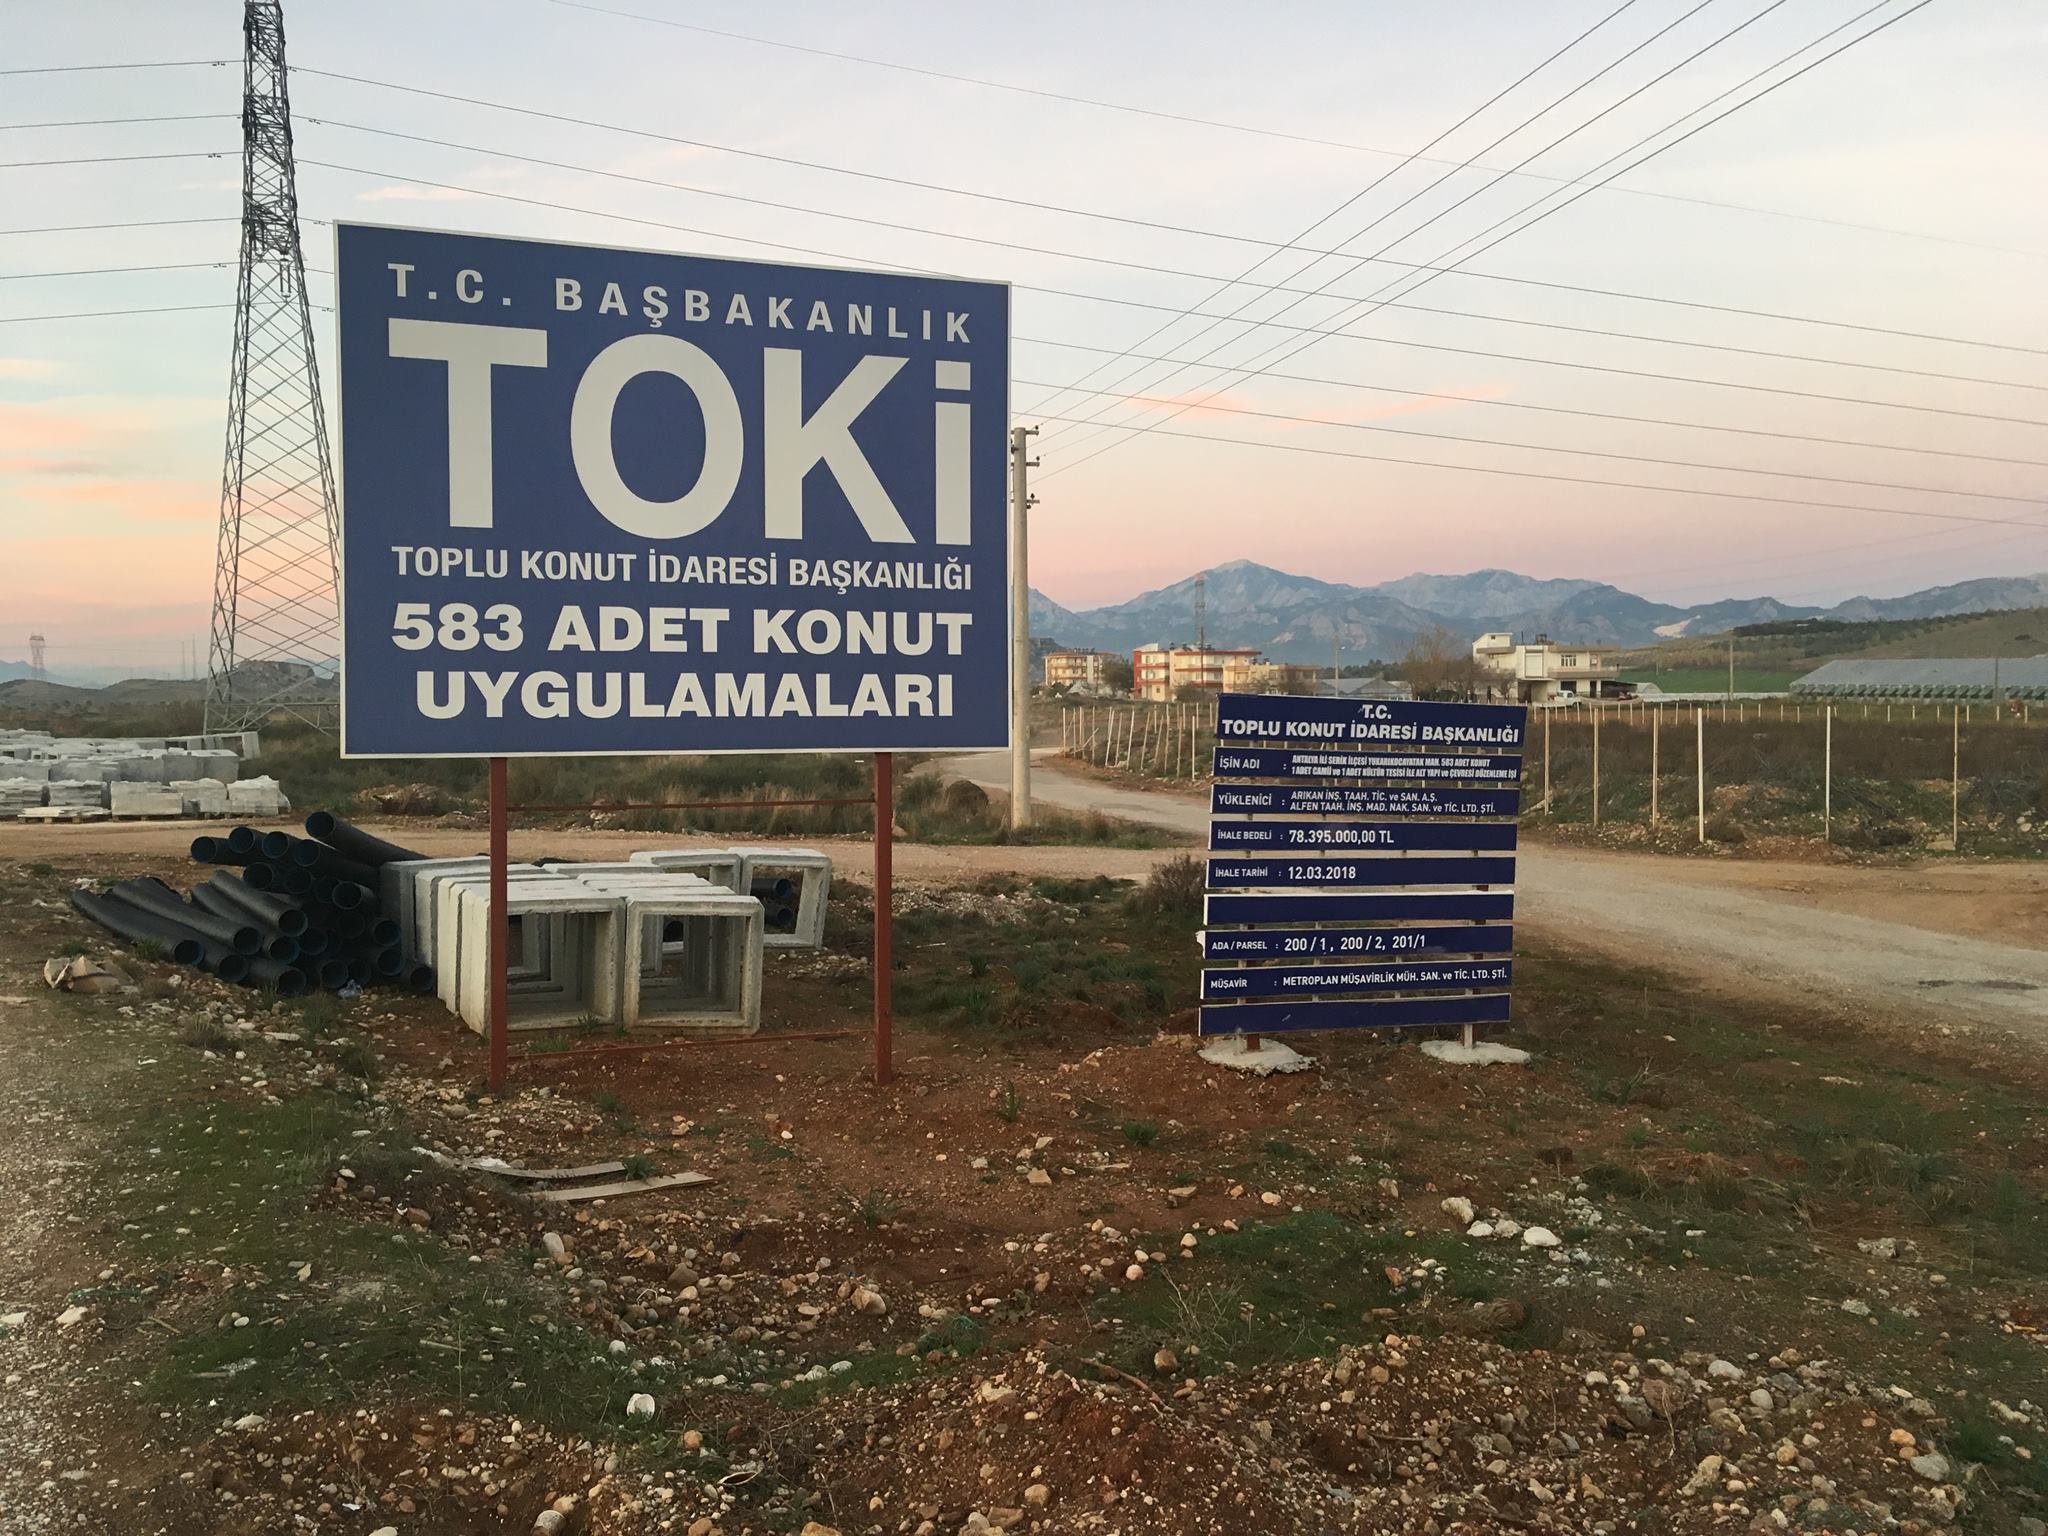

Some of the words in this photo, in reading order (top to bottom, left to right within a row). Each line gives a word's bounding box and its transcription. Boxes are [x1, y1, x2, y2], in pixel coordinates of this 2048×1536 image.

[387, 263, 513, 307] T.C.
[555, 277, 971, 345] BAŞBAKANLIK
[391, 546, 508, 578] TOPLU
[521, 551, 637, 583] KONUT
[648, 548, 777, 586] İDARESİ
[789, 556, 971, 595] BAŞKANLIĞI
[392, 603, 525, 651] 583
[548, 606, 730, 653] ADET
[753, 609, 973, 656] KONUT
[416, 671, 953, 719] UYGULAMALARI
[1362, 705, 1392, 720] T.C.
[1222, 720, 1281, 736] TOPLU
[1286, 722, 1345, 738] KONUT
[1350, 720, 1417, 740] İDARESİ
[1422, 725, 1518, 745] BAŞKANLIĞI
[1219, 757, 1240, 770] İŞİN
[1242, 758, 1260, 769] ADI
[1292, 755, 1318, 763] ANTALYA
[1328, 755, 1347, 764] SERİK
[1348, 755, 1367, 766] İLÇESİ
[1441, 758, 1453, 767] 583
[1455, 759, 1469, 767] ADET
[1471, 759, 1490, 767] KONUT
[1296, 767, 1311, 775] ADET
[1342, 768, 1345, 776] 1
[1346, 768, 1361, 776] ADET
[1362, 767, 1384, 776] KÜLTÜR
[1384, 767, 1405, 777] TESİSİ
[1427, 769, 1440, 777] YAPI
[1450, 768, 1474, 778] ÇEVRESİ
[1475, 769, 1507, 778] DÜZENLEME
[1218, 792, 1272, 806] YÜKLENİCİ
[1291, 791, 1324, 800] ARIKAN
[1325, 789, 1341, 802] İNŞ.
[1345, 792, 1369, 800] TAAH.
[1372, 790, 1387, 800] TİC.
[1389, 793, 1398, 801] ve
[1400, 793, 1420, 801] SAN.
[1421, 793, 1437, 802] A.Ş.
[1290, 802, 1318, 810] ALFEN
[1320, 802, 1344, 810] TAAH.
[1347, 801, 1363, 812] İNŞ.
[1366, 803, 1387, 811] MAD.
[1389, 803, 1410, 812] NAK.
[1412, 804, 1430, 812] SAN.
[1444, 802, 1459, 812] TİC.
[1461, 804, 1478, 812] LTD.
[1481, 802, 1495, 814] ŞTİ.
[1218, 829, 1241, 840] İHALE
[1243, 829, 1272, 840] BEDELİ
[1289, 830, 1376, 844] 78.395.000,00
[1379, 831, 1394, 844] TL
[1215, 867, 1239, 877] İHALE
[1241, 866, 1268, 877] TARİHİ
[1288, 867, 1356, 879] 12.03.2018
[1212, 942, 1229, 950] ADA
[1236, 941, 1267, 950] PARSEL
[1284, 938, 1308, 952] 200
[1341, 937, 1363, 950] 200
[1392, 934, 1425, 949] 201/1
[1211, 977, 1247, 989] MÜŞAVİR
[1283, 973, 1338, 986] METROPLAN
[1340, 970, 1395, 985] MÜŞAVİRLİK
[1396, 968, 1419, 982] MÜH.
[1421, 969, 1440, 979] SAN.
[1442, 972, 1452, 980] ve
[1454, 969, 1469, 979] TİC.
[1472, 969, 1489, 979] LTD.
[1491, 967, 1507, 980] ŞTİ.
